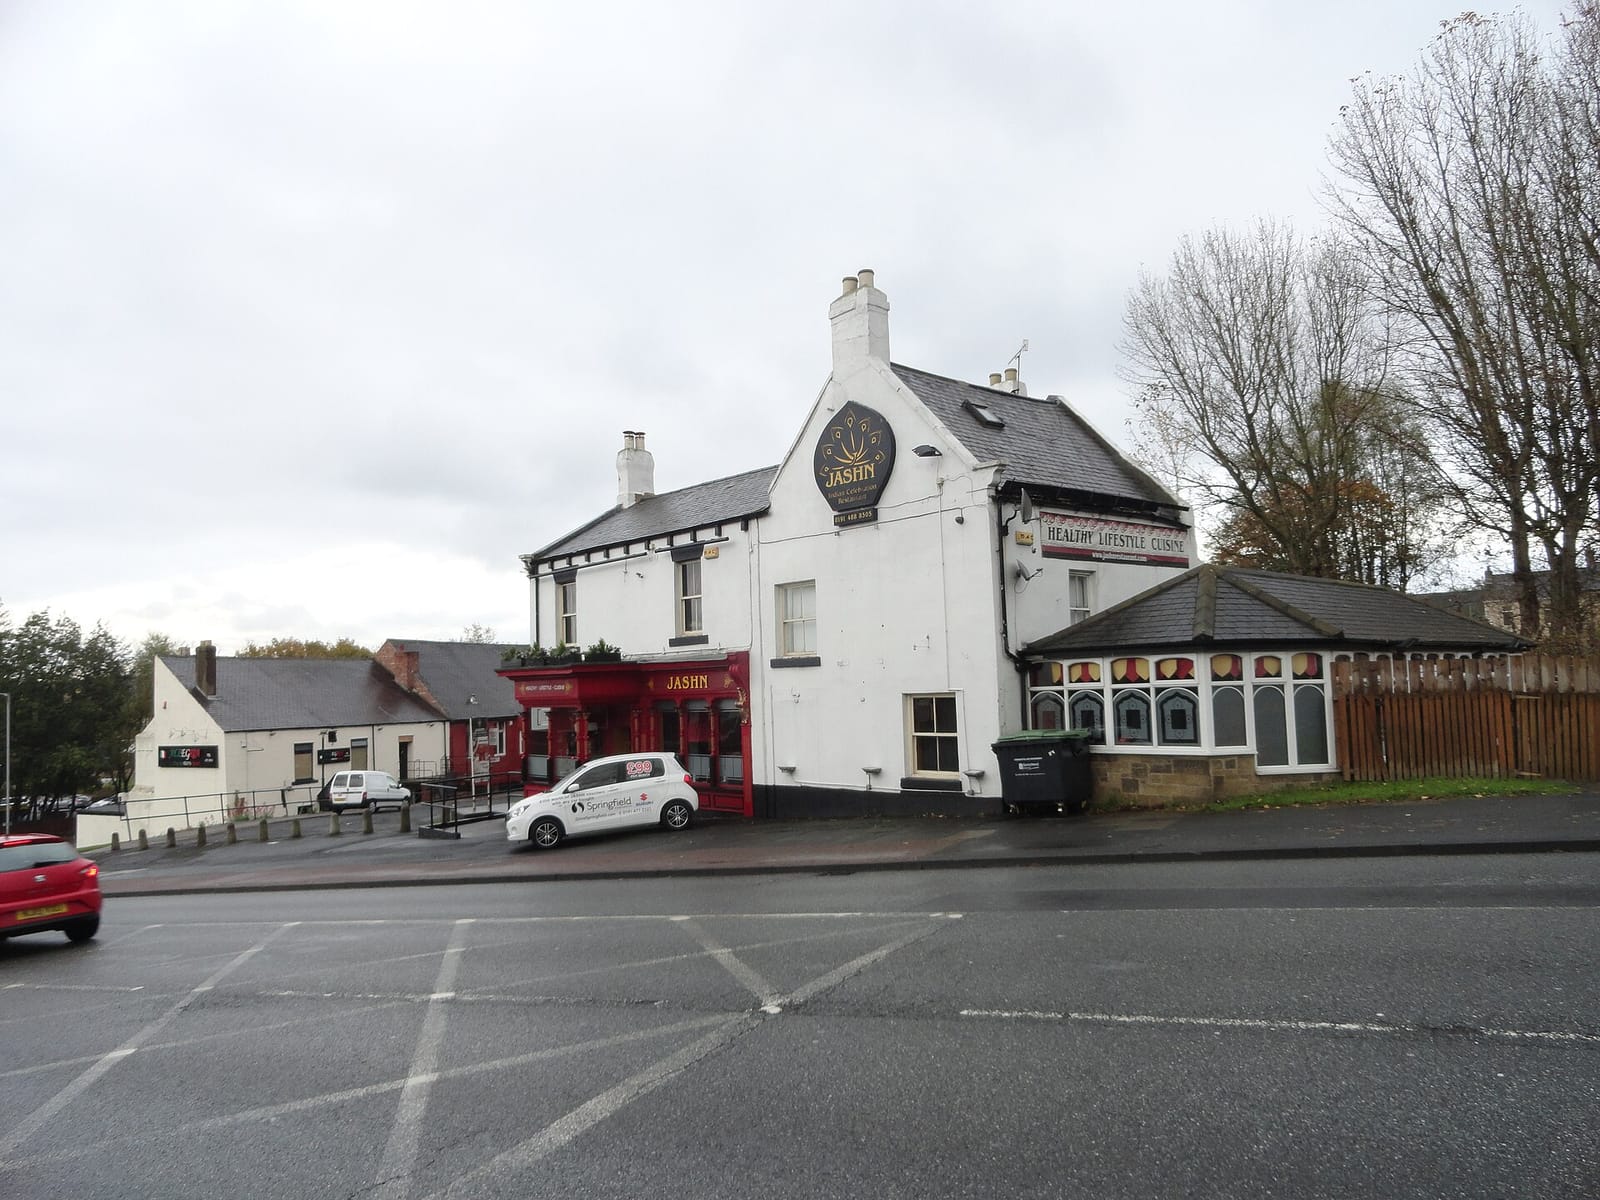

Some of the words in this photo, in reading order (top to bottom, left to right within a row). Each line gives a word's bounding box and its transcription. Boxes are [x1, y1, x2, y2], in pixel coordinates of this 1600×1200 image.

[825, 463, 875, 488] JASHN
[1048, 527, 1094, 545] HEALTHY
[1099, 532, 1146, 550] LIFESTYLE
[1151, 537, 1184, 553] CUISINE
[667, 675, 708, 690] JASHN
[626, 760, 652, 774] £99
[586, 797, 632, 812] Springfield
